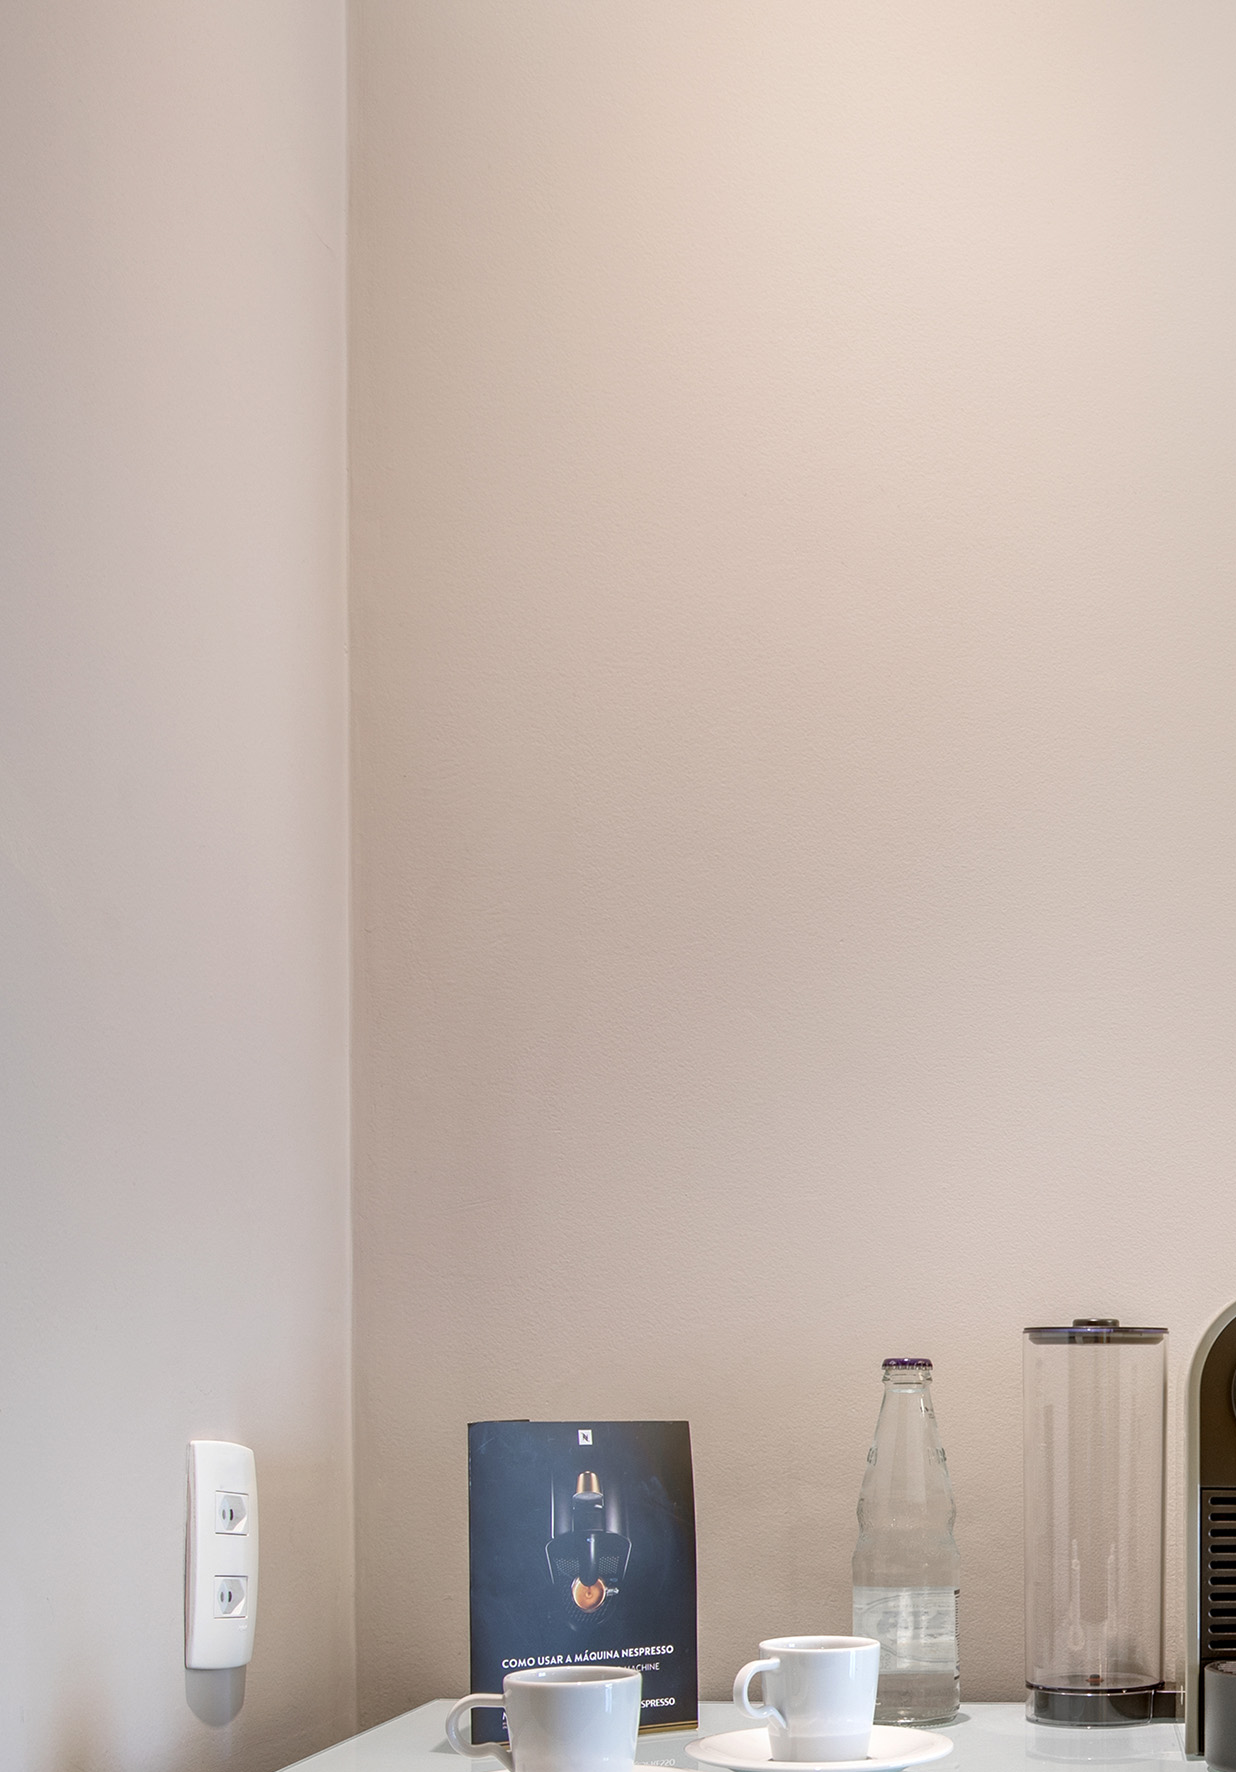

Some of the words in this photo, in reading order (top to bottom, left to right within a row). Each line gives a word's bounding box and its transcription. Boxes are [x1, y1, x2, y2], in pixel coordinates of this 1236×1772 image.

[501, 1657, 535, 1669] COMO
[537, 1654, 564, 1666] USAR
[565, 1654, 573, 1664] A
[574, 1649, 620, 1663] MÁQUINA
[621, 1644, 674, 1658] NESPRESSO
